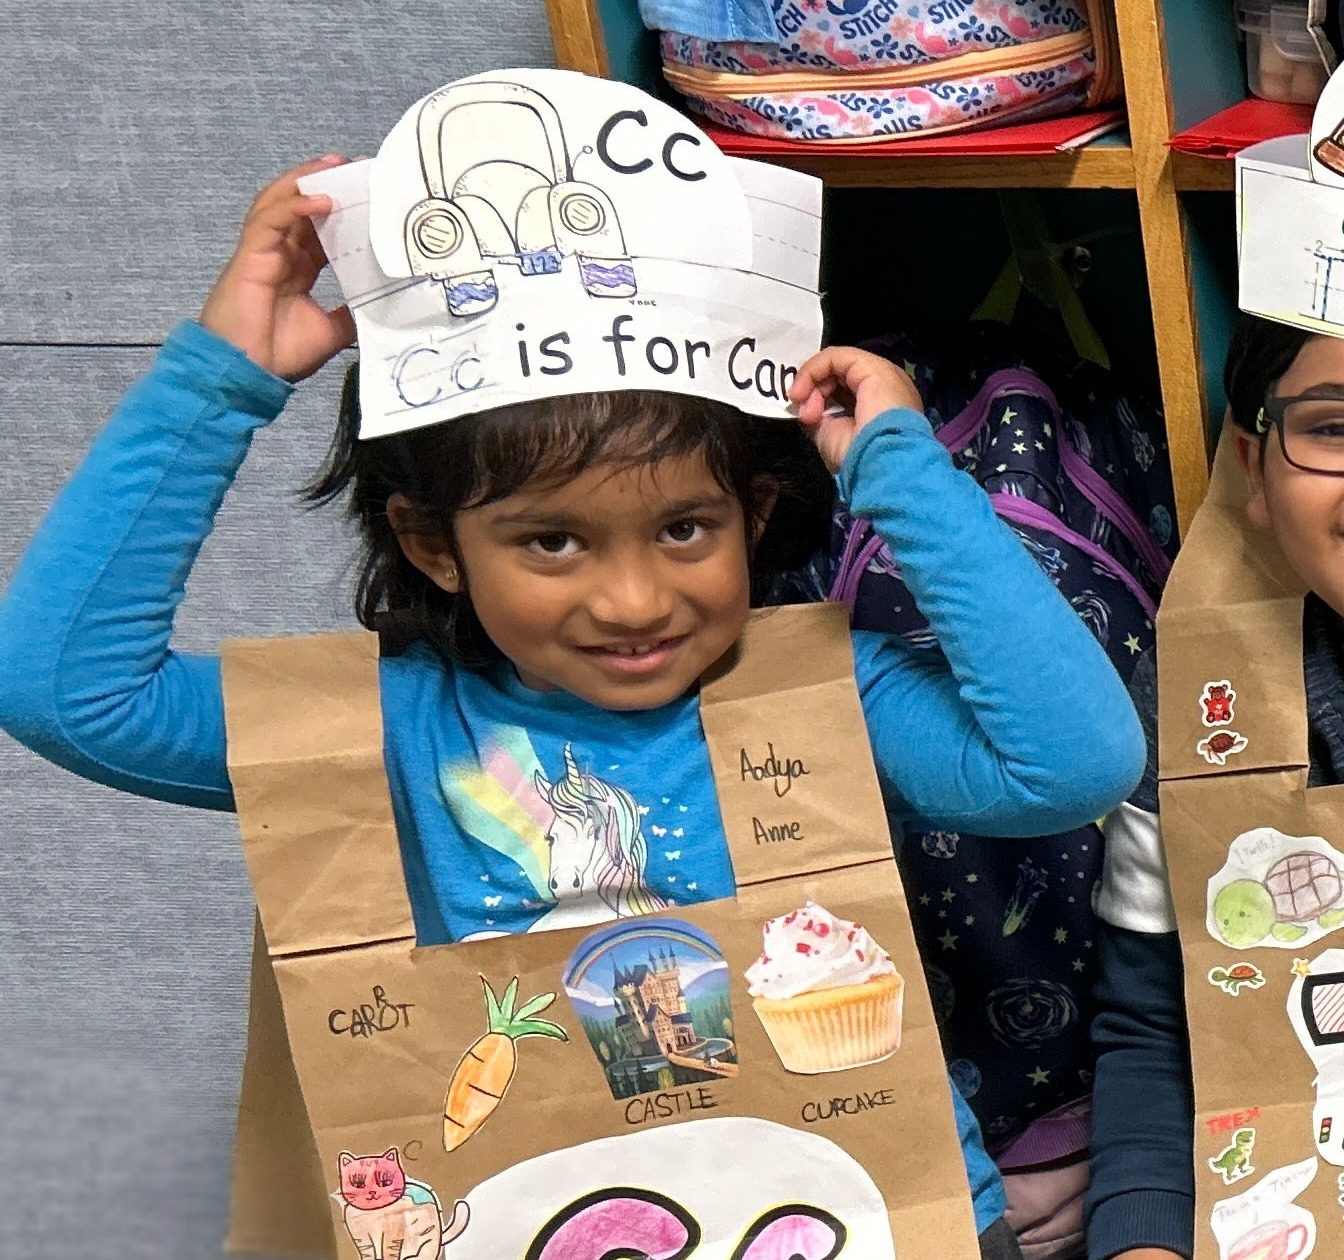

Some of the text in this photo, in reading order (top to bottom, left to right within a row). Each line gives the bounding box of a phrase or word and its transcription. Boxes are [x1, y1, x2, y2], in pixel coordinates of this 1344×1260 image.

[595, 109, 707, 182] Cc
[515, 322, 574, 379] is
[602, 314, 711, 380] for
[740, 741, 810, 798] Aadya
[752, 817, 805, 845] Anne
[625, 1087, 719, 1125] CASTLE
[801, 1088, 897, 1123] CUPCAKE
